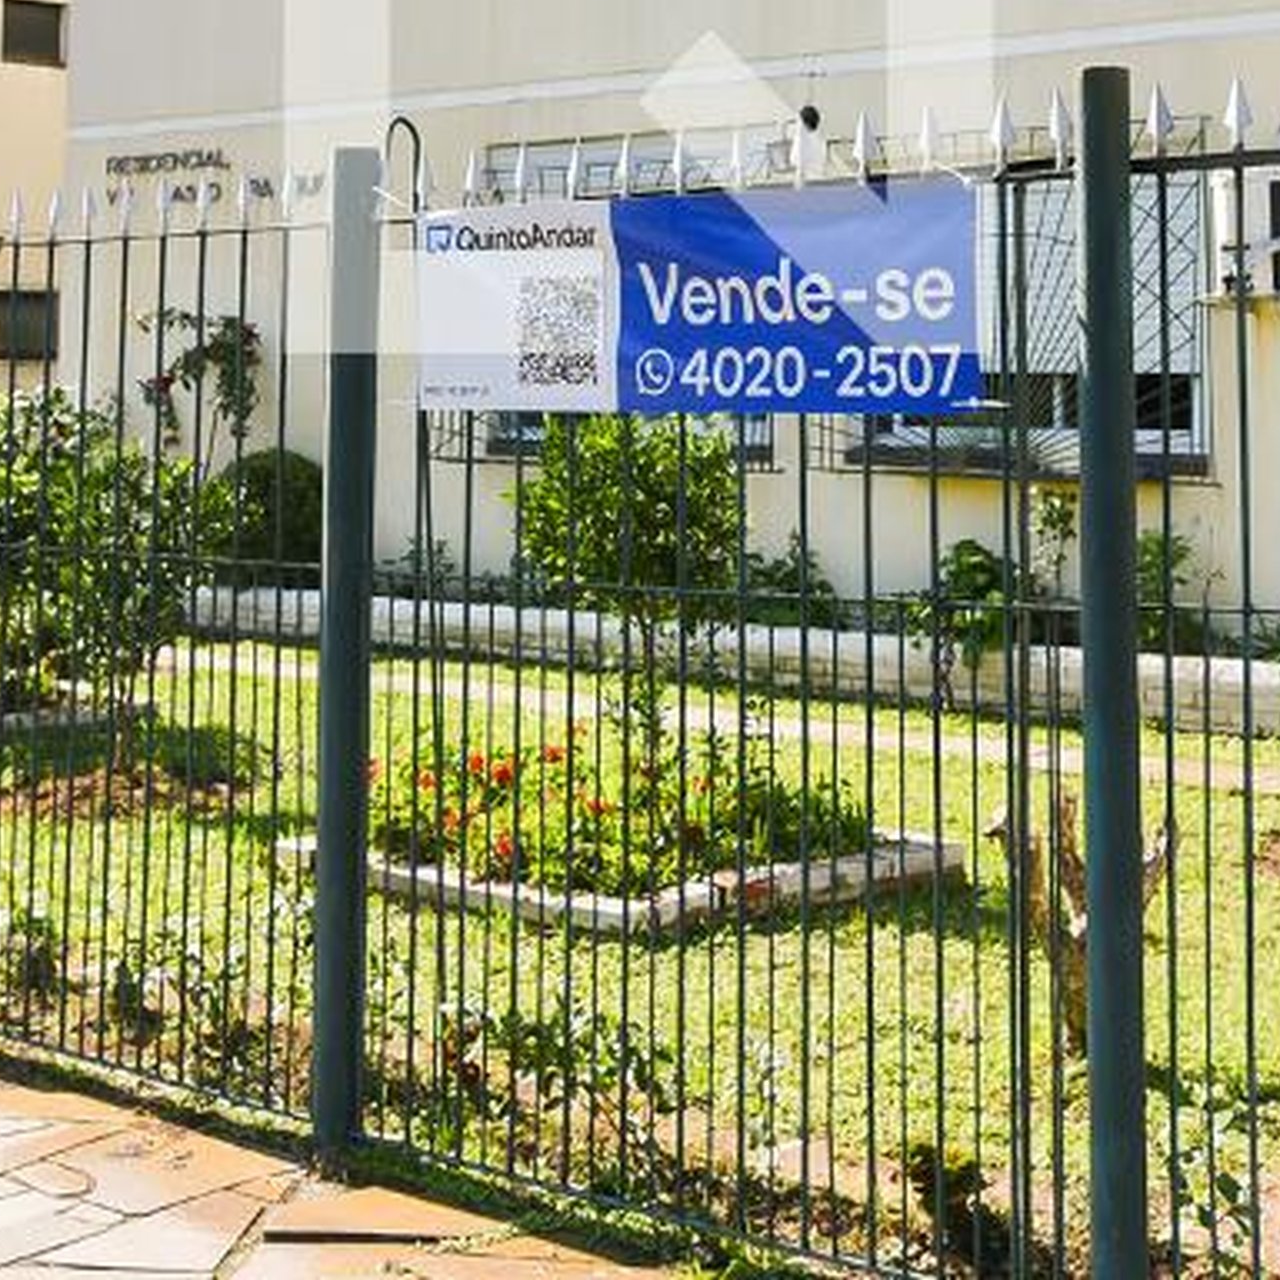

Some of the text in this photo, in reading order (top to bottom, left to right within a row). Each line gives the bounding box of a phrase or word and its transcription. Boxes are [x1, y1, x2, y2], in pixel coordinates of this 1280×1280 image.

[455, 222, 597, 252] QuintoAndar
[637, 257, 955, 325] Vende-se
[679, 342, 961, 398] 4020-2507
